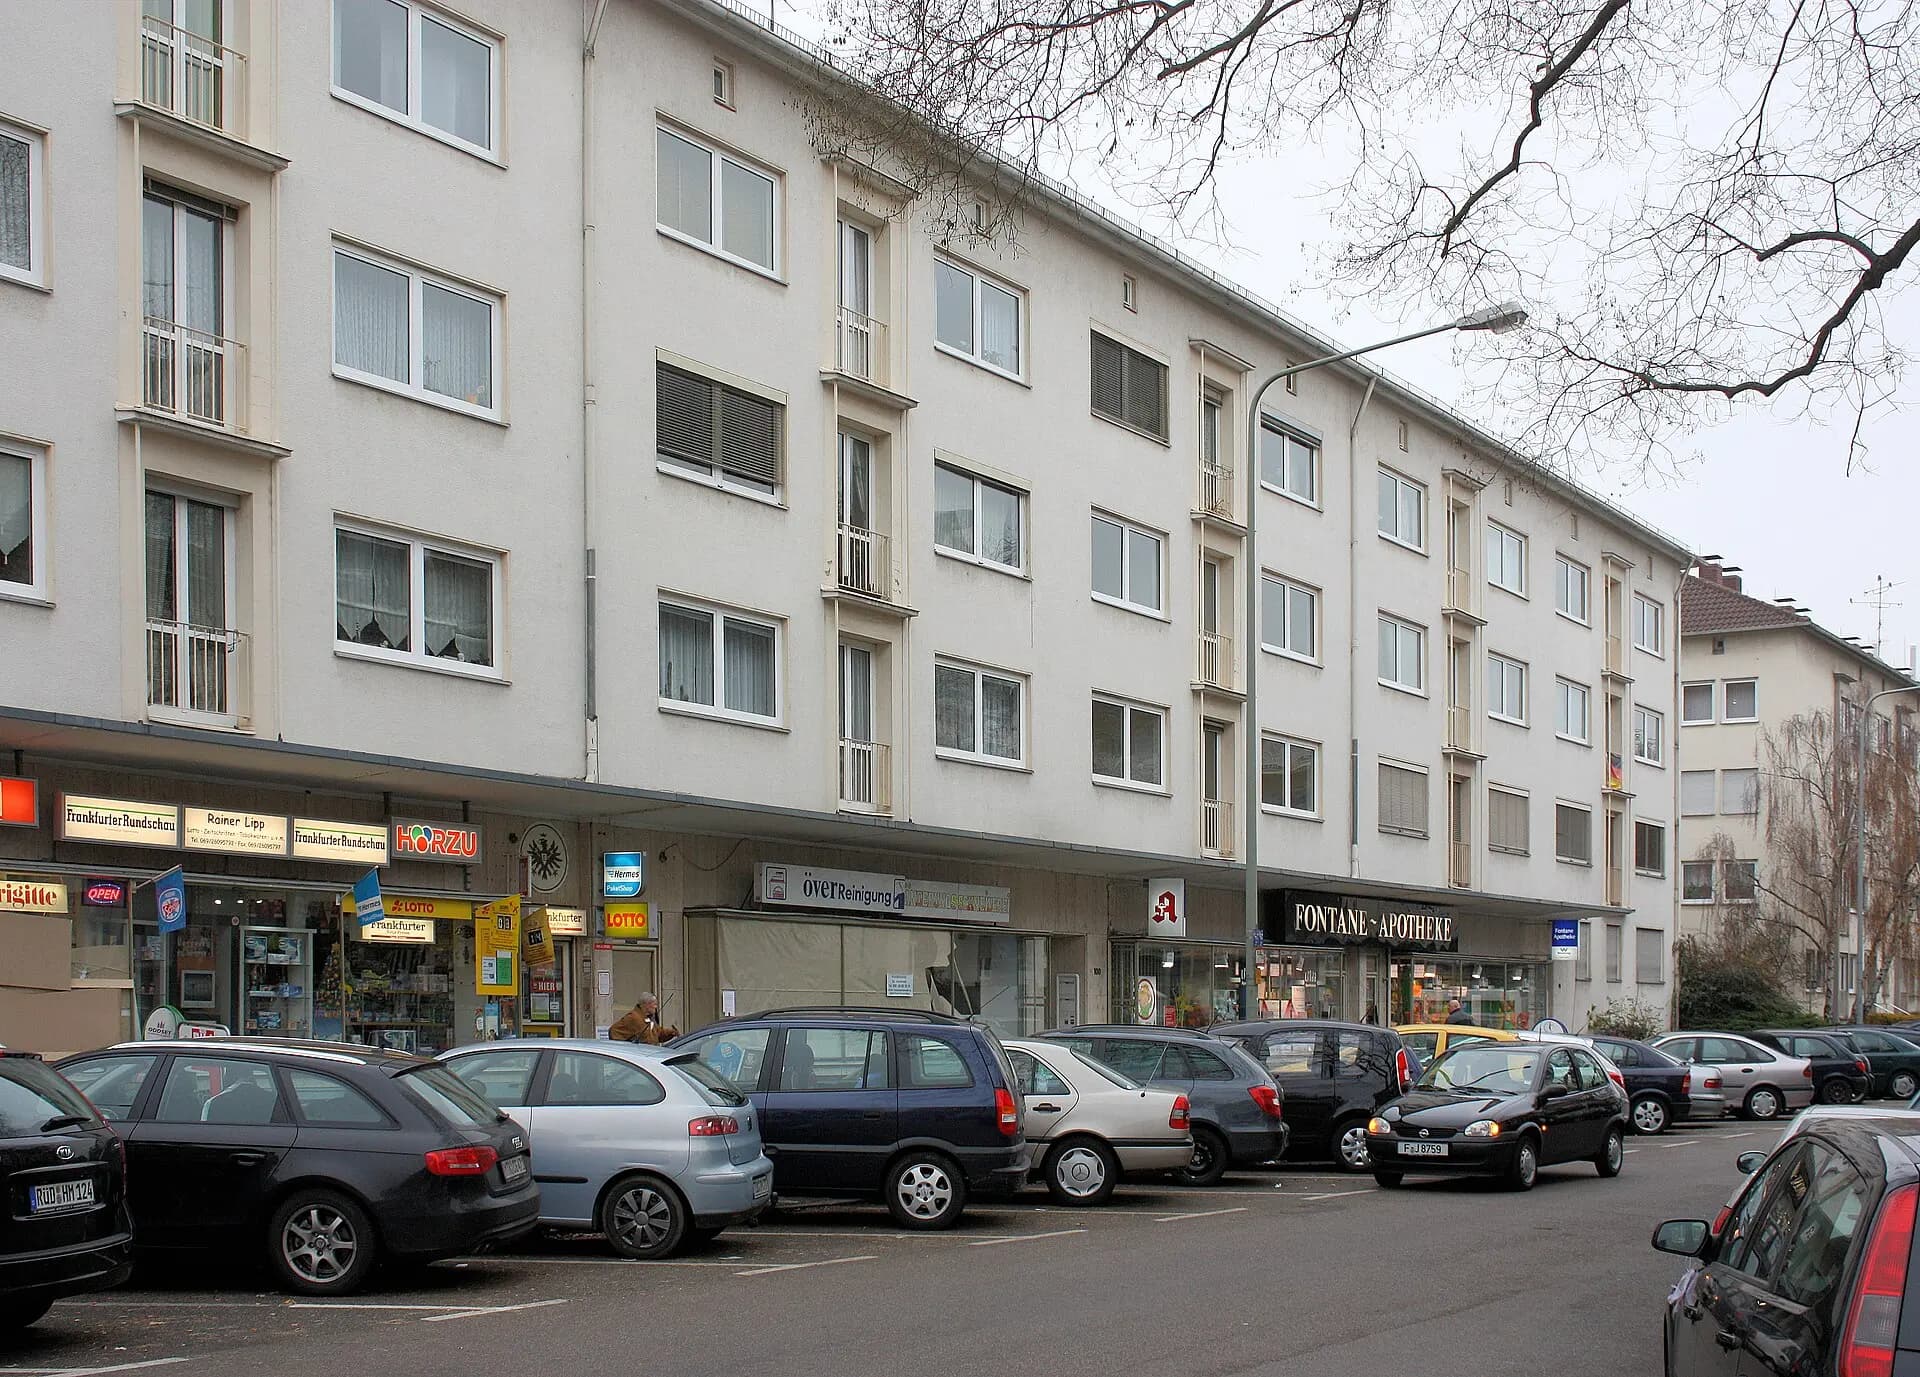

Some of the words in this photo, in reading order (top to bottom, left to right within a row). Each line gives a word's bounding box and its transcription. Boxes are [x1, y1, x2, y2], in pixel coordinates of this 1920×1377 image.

[207, 813, 241, 827] Rainer
[245, 817, 265, 831] Lipp
[614, 870, 640, 878] Hermes
[0, 884, 57, 909] rigitte
[88, 889, 121, 900] OPEN
[838, 883, 892, 907] Reinigung
[405, 902, 434, 913] LOTTO
[547, 911, 582, 923] nkfurter
[607, 912, 647, 928] LOTTO
[1295, 903, 1368, 936] FONTANE
[1379, 913, 1452, 942] APOTHEKE
[371, 920, 426, 931] Frankfurter
[538, 981, 555, 991] HIER
[1420, 1144, 1442, 1154] 8759
[36, 1186, 56, 1207] RÜD
[75, 1180, 94, 1201] 124
